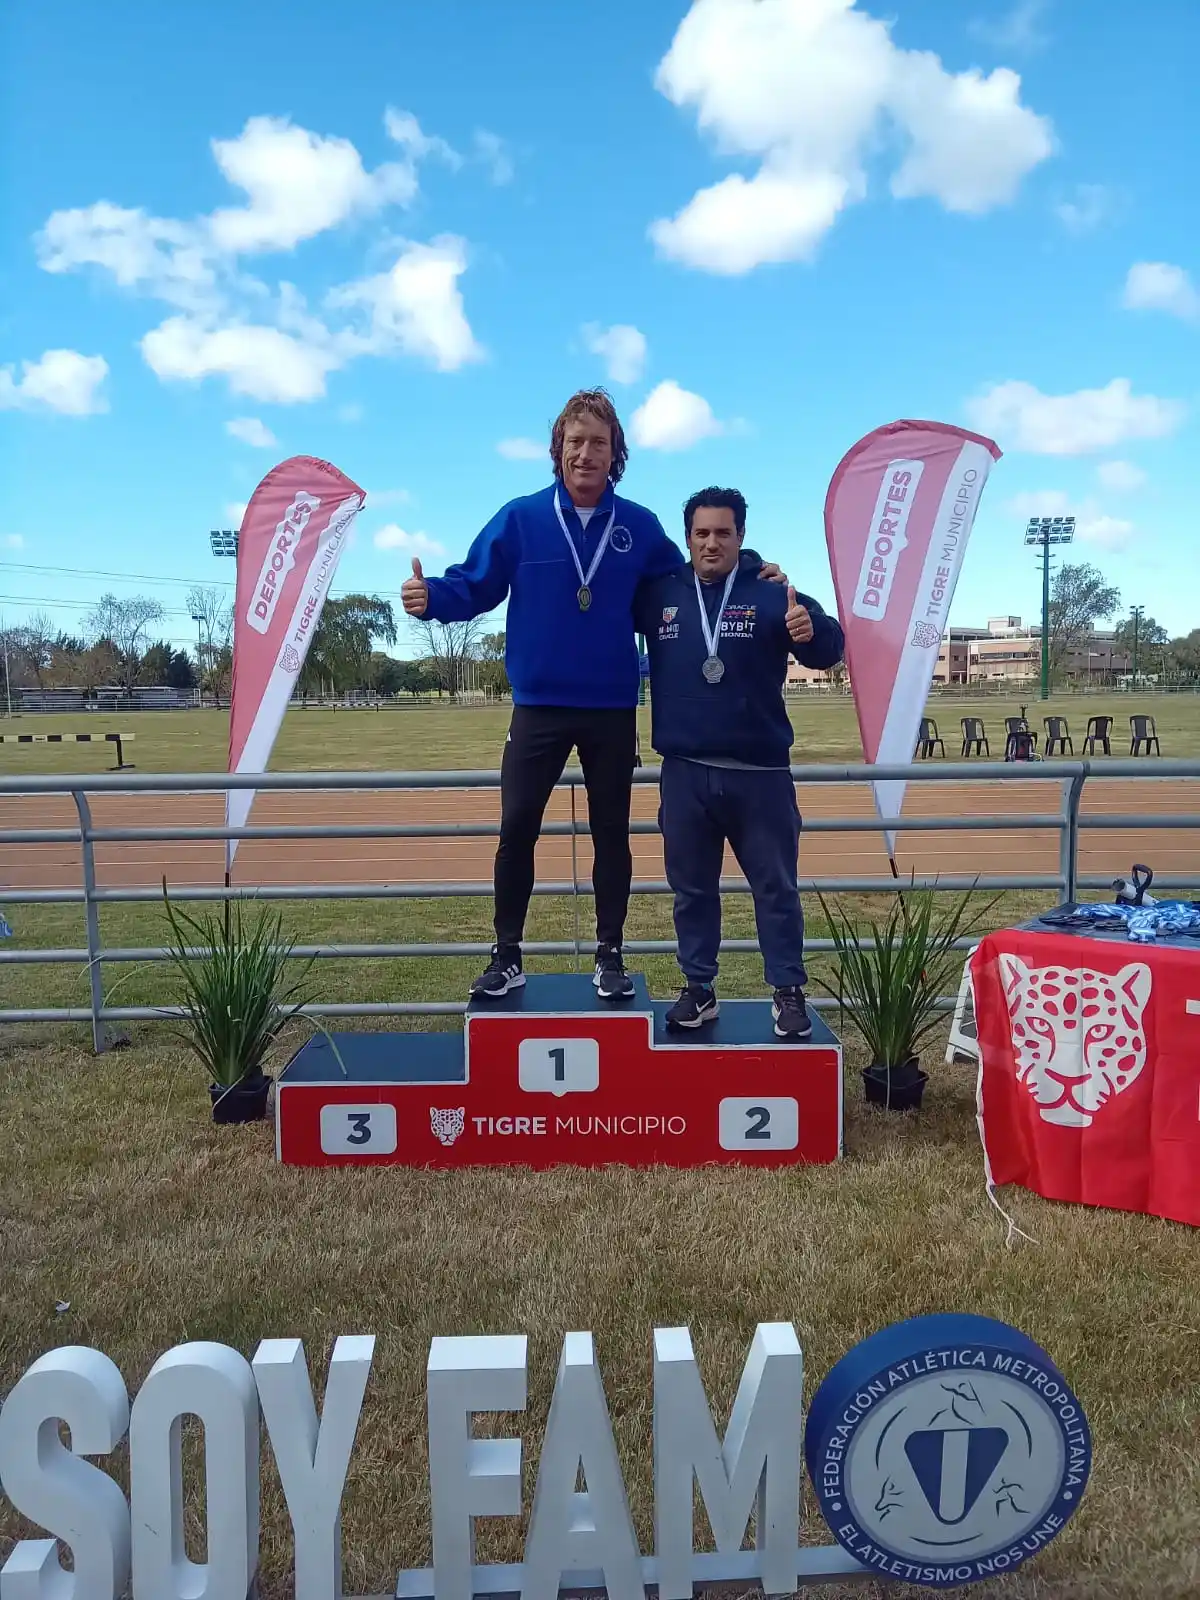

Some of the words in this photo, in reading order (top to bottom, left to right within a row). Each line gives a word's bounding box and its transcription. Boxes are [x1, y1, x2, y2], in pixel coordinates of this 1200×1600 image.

[254, 501, 312, 621] DEPORTES
[862, 470, 911, 608] DEPORTES
[926, 566, 950, 617] TIGRE
[942, 469, 978, 562] MUNICIPIO
[294, 595, 315, 643] TIGRE
[721, 620, 756, 631] BYBIT
[548, 1048, 565, 1081] 1
[346, 1113, 372, 1145] 3
[472, 1117, 547, 1135] TIGRE
[556, 1116, 686, 1135] MUNICIPIO
[745, 1107, 771, 1139] 2
[824, 1379, 887, 1499] FEDERACIÓN
[888, 1350, 987, 1386] ATLÉTICA
[992, 1354, 1085, 1487] METROPOLITANA
[0, 1335, 375, 1600] SOY
[427, 1322, 803, 1600] FAM
[838, 1523, 858, 1548] EL
[856, 1546, 972, 1582] ATLETISMO
[977, 1546, 1024, 1575] NOS
[1023, 1514, 1064, 1550] UNE
